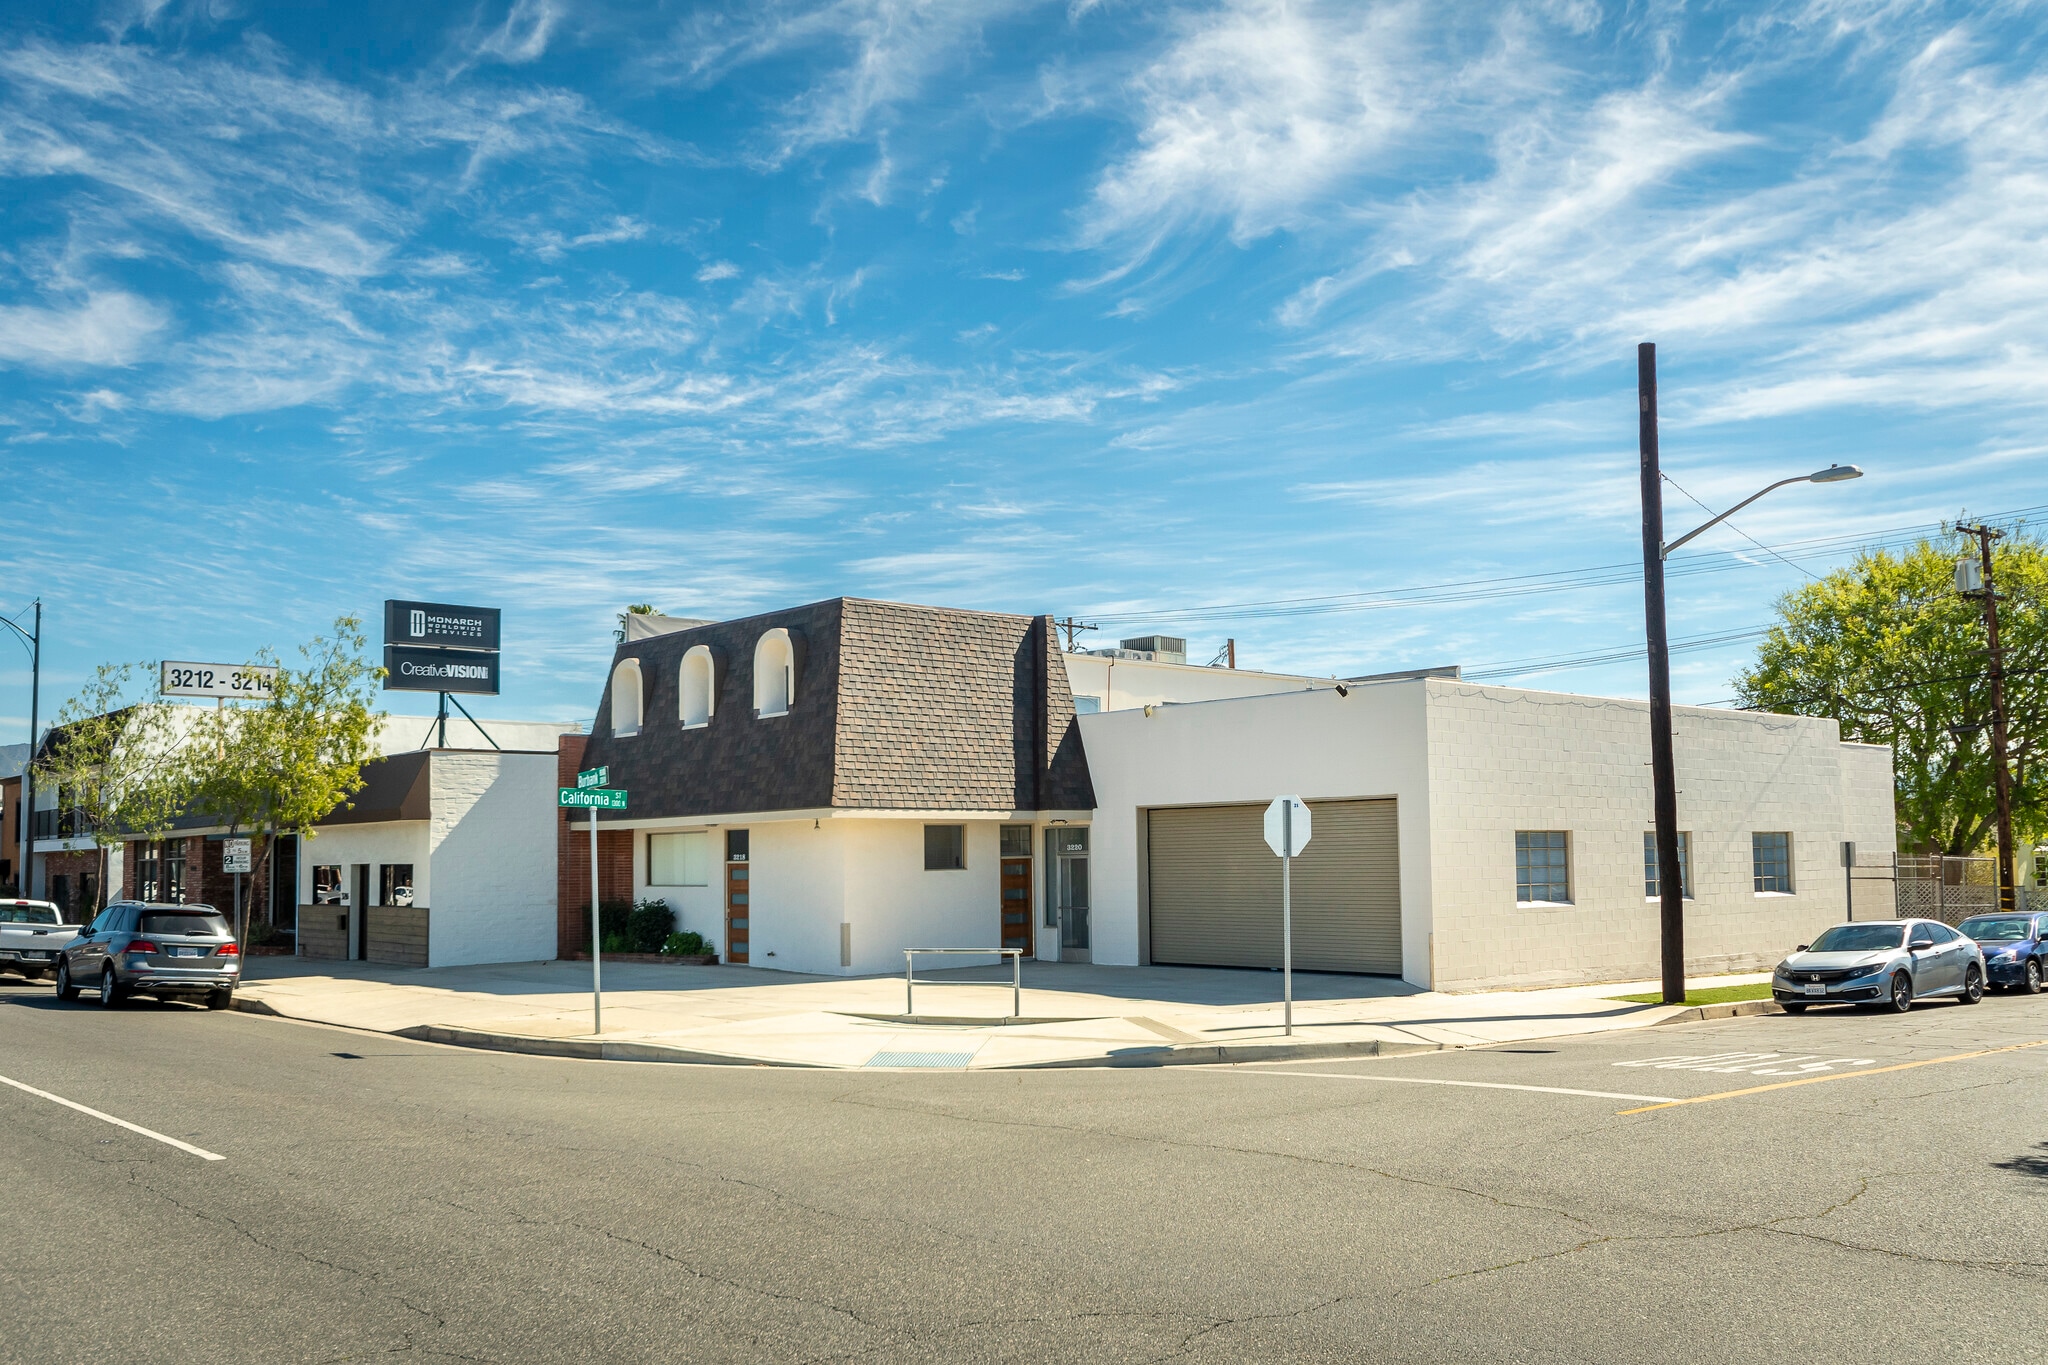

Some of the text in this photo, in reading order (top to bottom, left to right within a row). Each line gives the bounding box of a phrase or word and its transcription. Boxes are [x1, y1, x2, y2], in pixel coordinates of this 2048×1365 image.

[427, 616, 482, 626] MONARCH
[427, 623, 482, 632] WORLDWIDE
[427, 628, 482, 637] SERVICES
[171, 669, 214, 688] 3212
[561, 790, 610, 806] California
[1611, 1051, 1877, 1076] STOP
